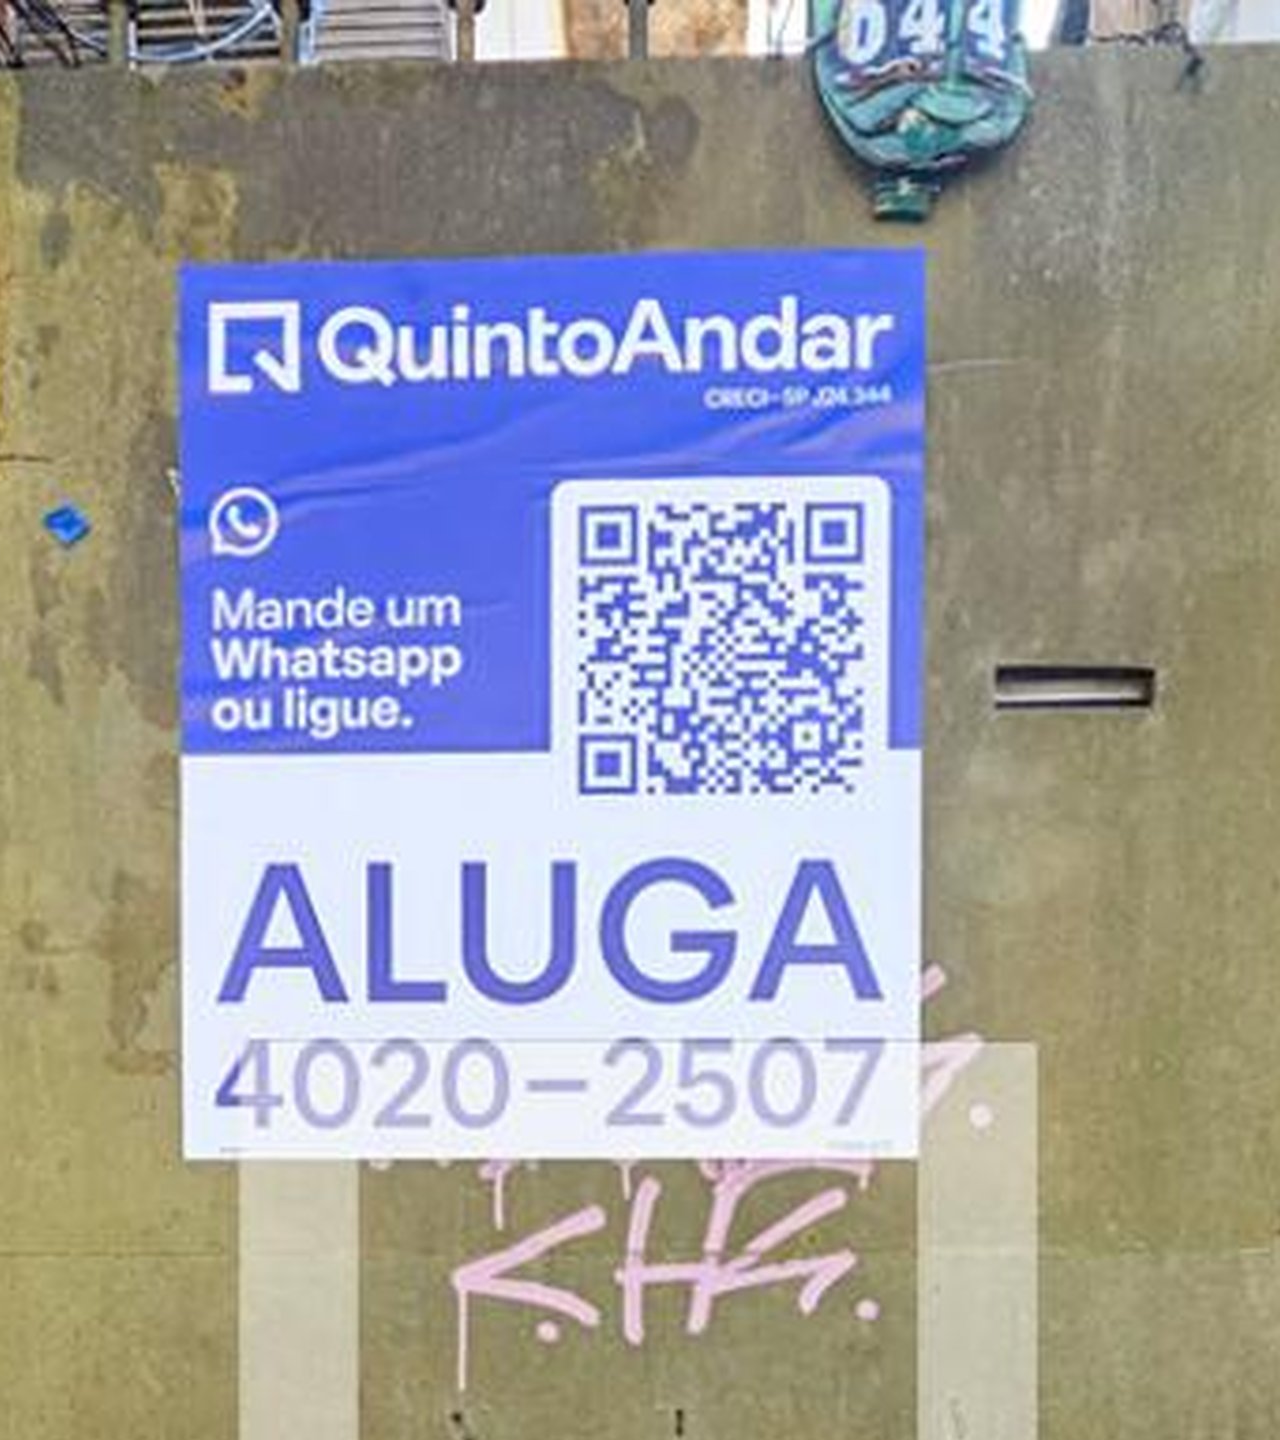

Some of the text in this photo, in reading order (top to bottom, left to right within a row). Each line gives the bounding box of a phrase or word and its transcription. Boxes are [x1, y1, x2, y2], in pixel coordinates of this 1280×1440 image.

[318, 296, 893, 387] QuintoAndar
[212, 588, 462, 631] Mande um
[211, 637, 463, 688] Whatsapp
[211, 686, 414, 740] ou ligue.
[216, 857, 884, 1006] ALUGA
[214, 1037, 887, 1130] 4020-2507
